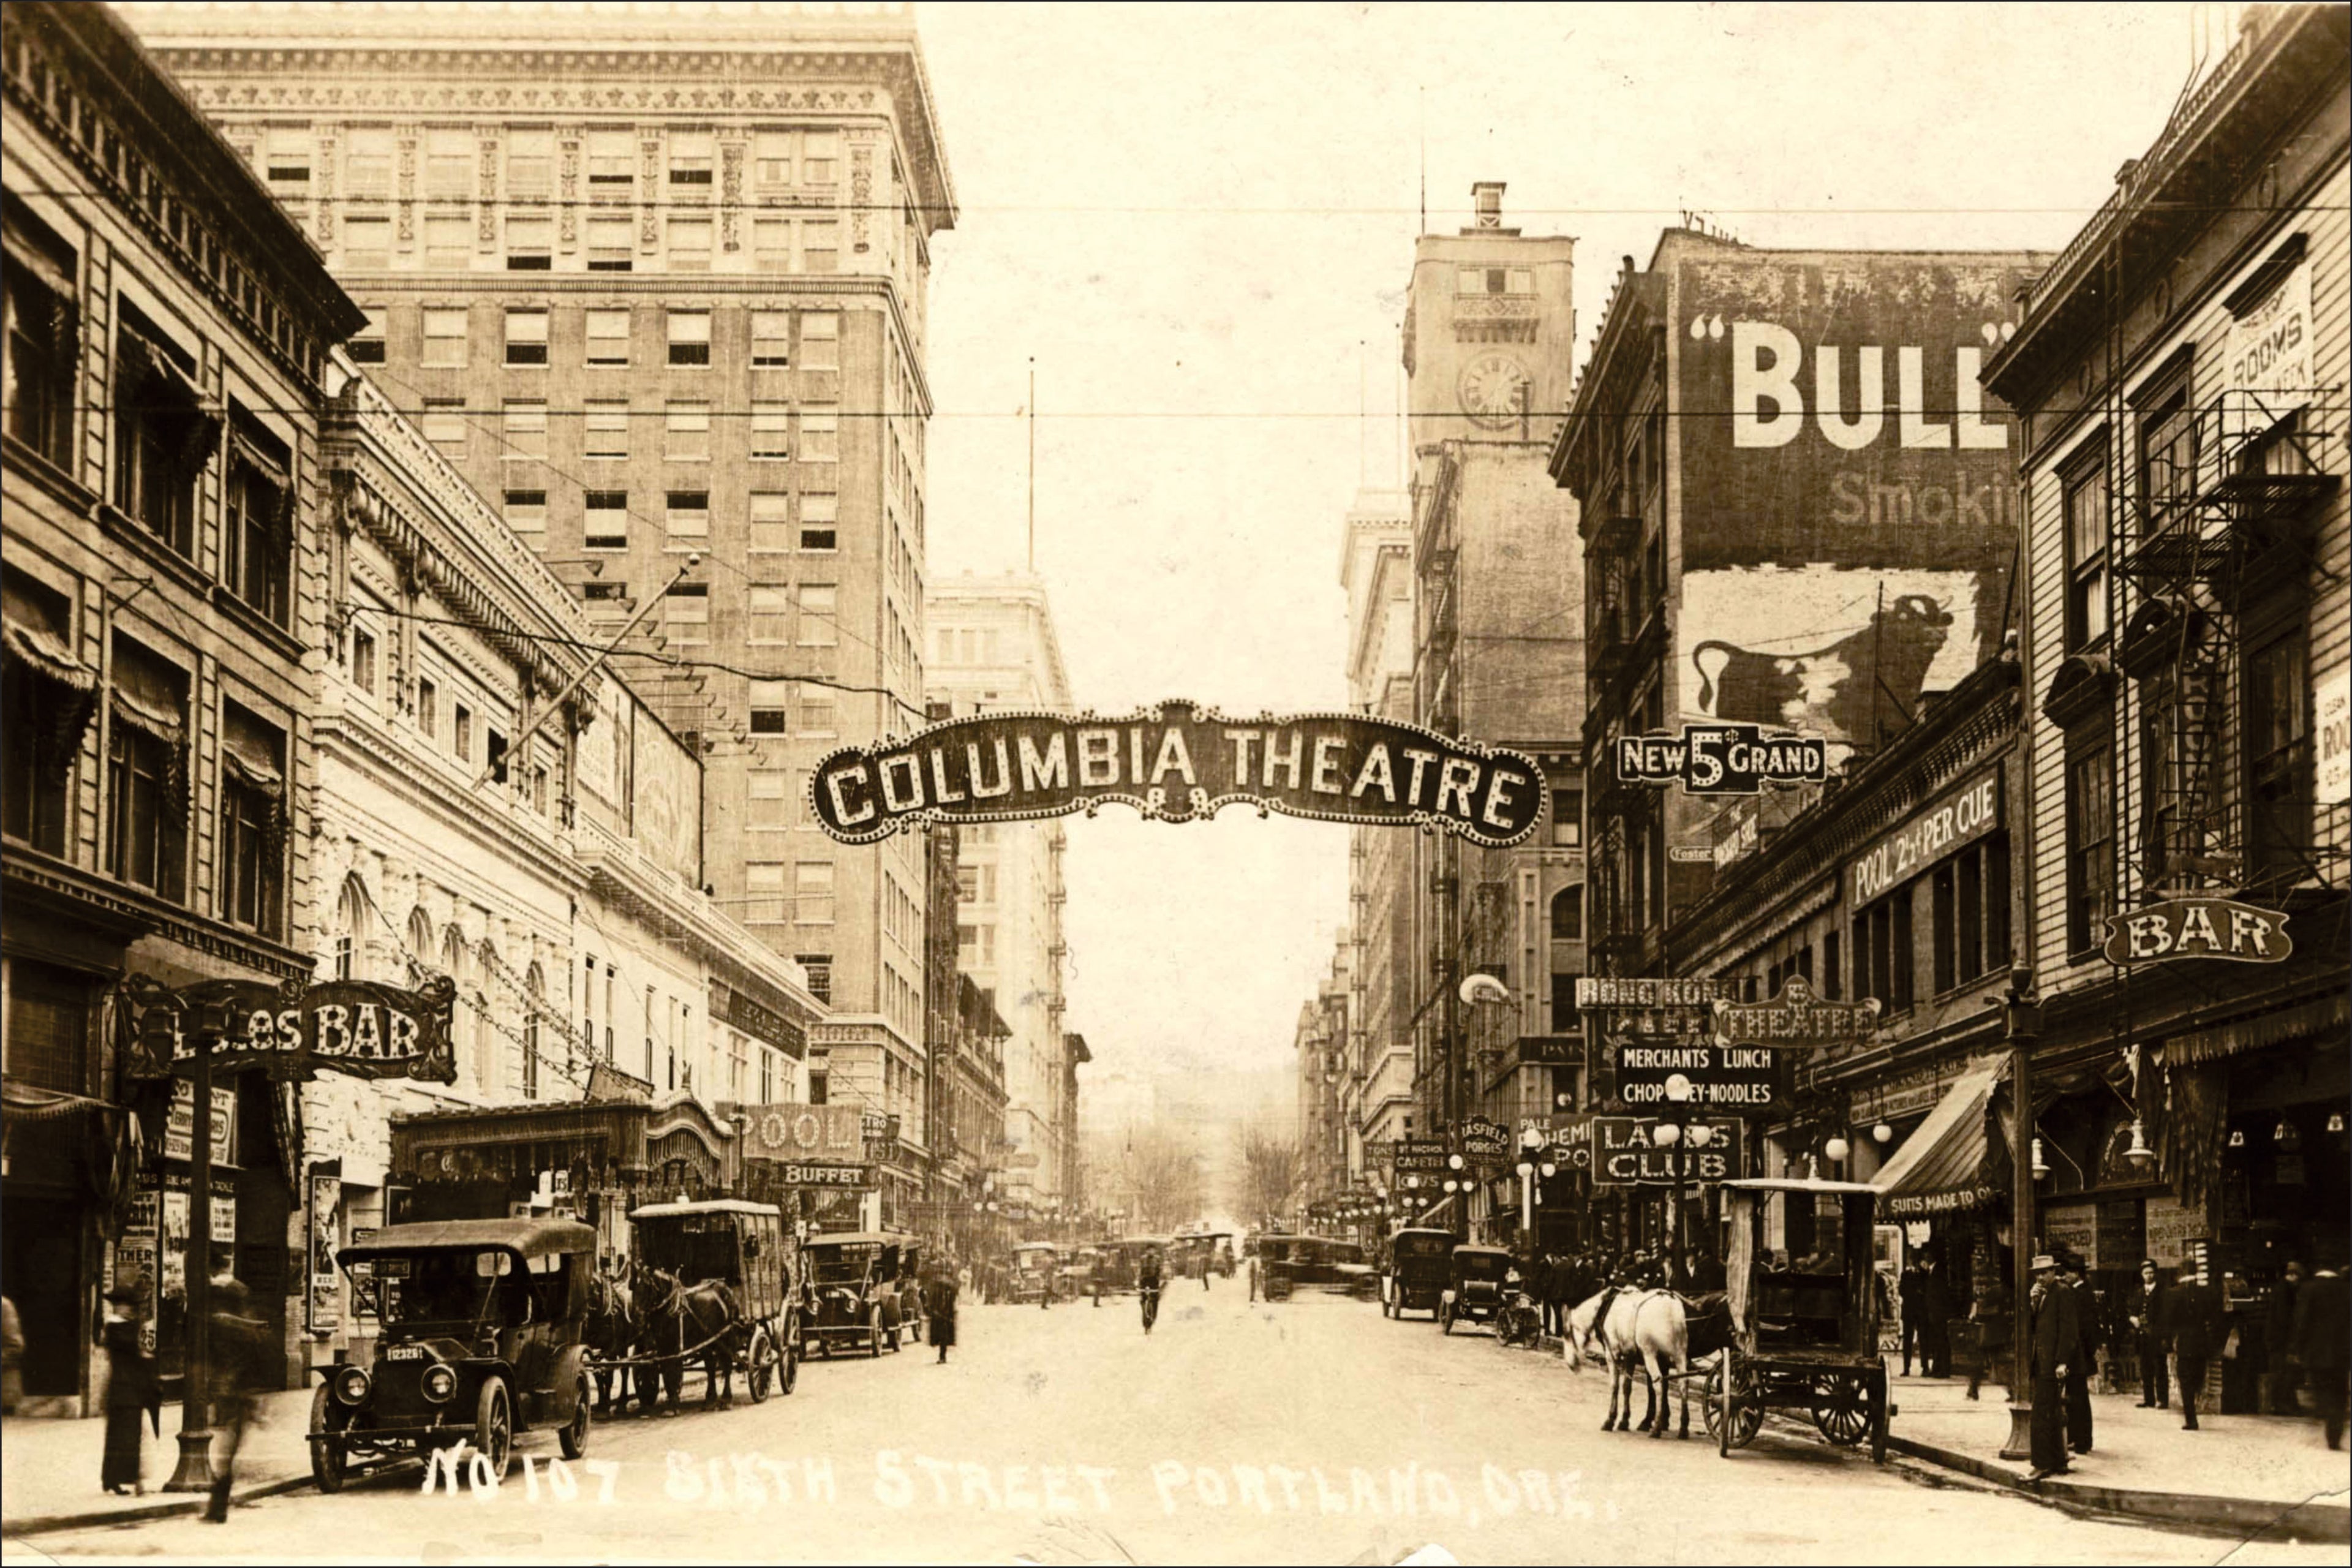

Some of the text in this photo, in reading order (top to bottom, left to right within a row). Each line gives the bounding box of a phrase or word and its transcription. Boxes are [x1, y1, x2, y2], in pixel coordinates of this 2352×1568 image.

[2234, 312, 2302, 386] ROOMS
[1624, 741, 1687, 772] NEW
[1728, 743, 1820, 774] GRAND
[826, 726, 1529, 829] COLUMBIA THEATRE
[1856, 843, 1893, 905] POOL
[1923, 807, 1954, 856] PER
[1957, 778, 1994, 833] CUE
[2127, 907, 2271, 959] BAR
[1581, 980, 1654, 1005] HONG
[313, 1003, 424, 1058] BAR
[1728, 1008, 1874, 1038] THEATRE
[1624, 1049, 1771, 1068] MERCHANTS LUNCH
[1624, 1084, 1771, 1102] CHOP EY-NOODLES
[1520, 1118, 1551, 1129] PALE
[1604, 1125, 1730, 1148] LAS
[785, 1167, 864, 1183] BUFFET
[1607, 1155, 1727, 1177] CLUB
[1891, 1197, 1923, 1214] SUITS
[1926, 1193, 1958, 1210] MADE
[1959, 1191, 1974, 1206] TO
